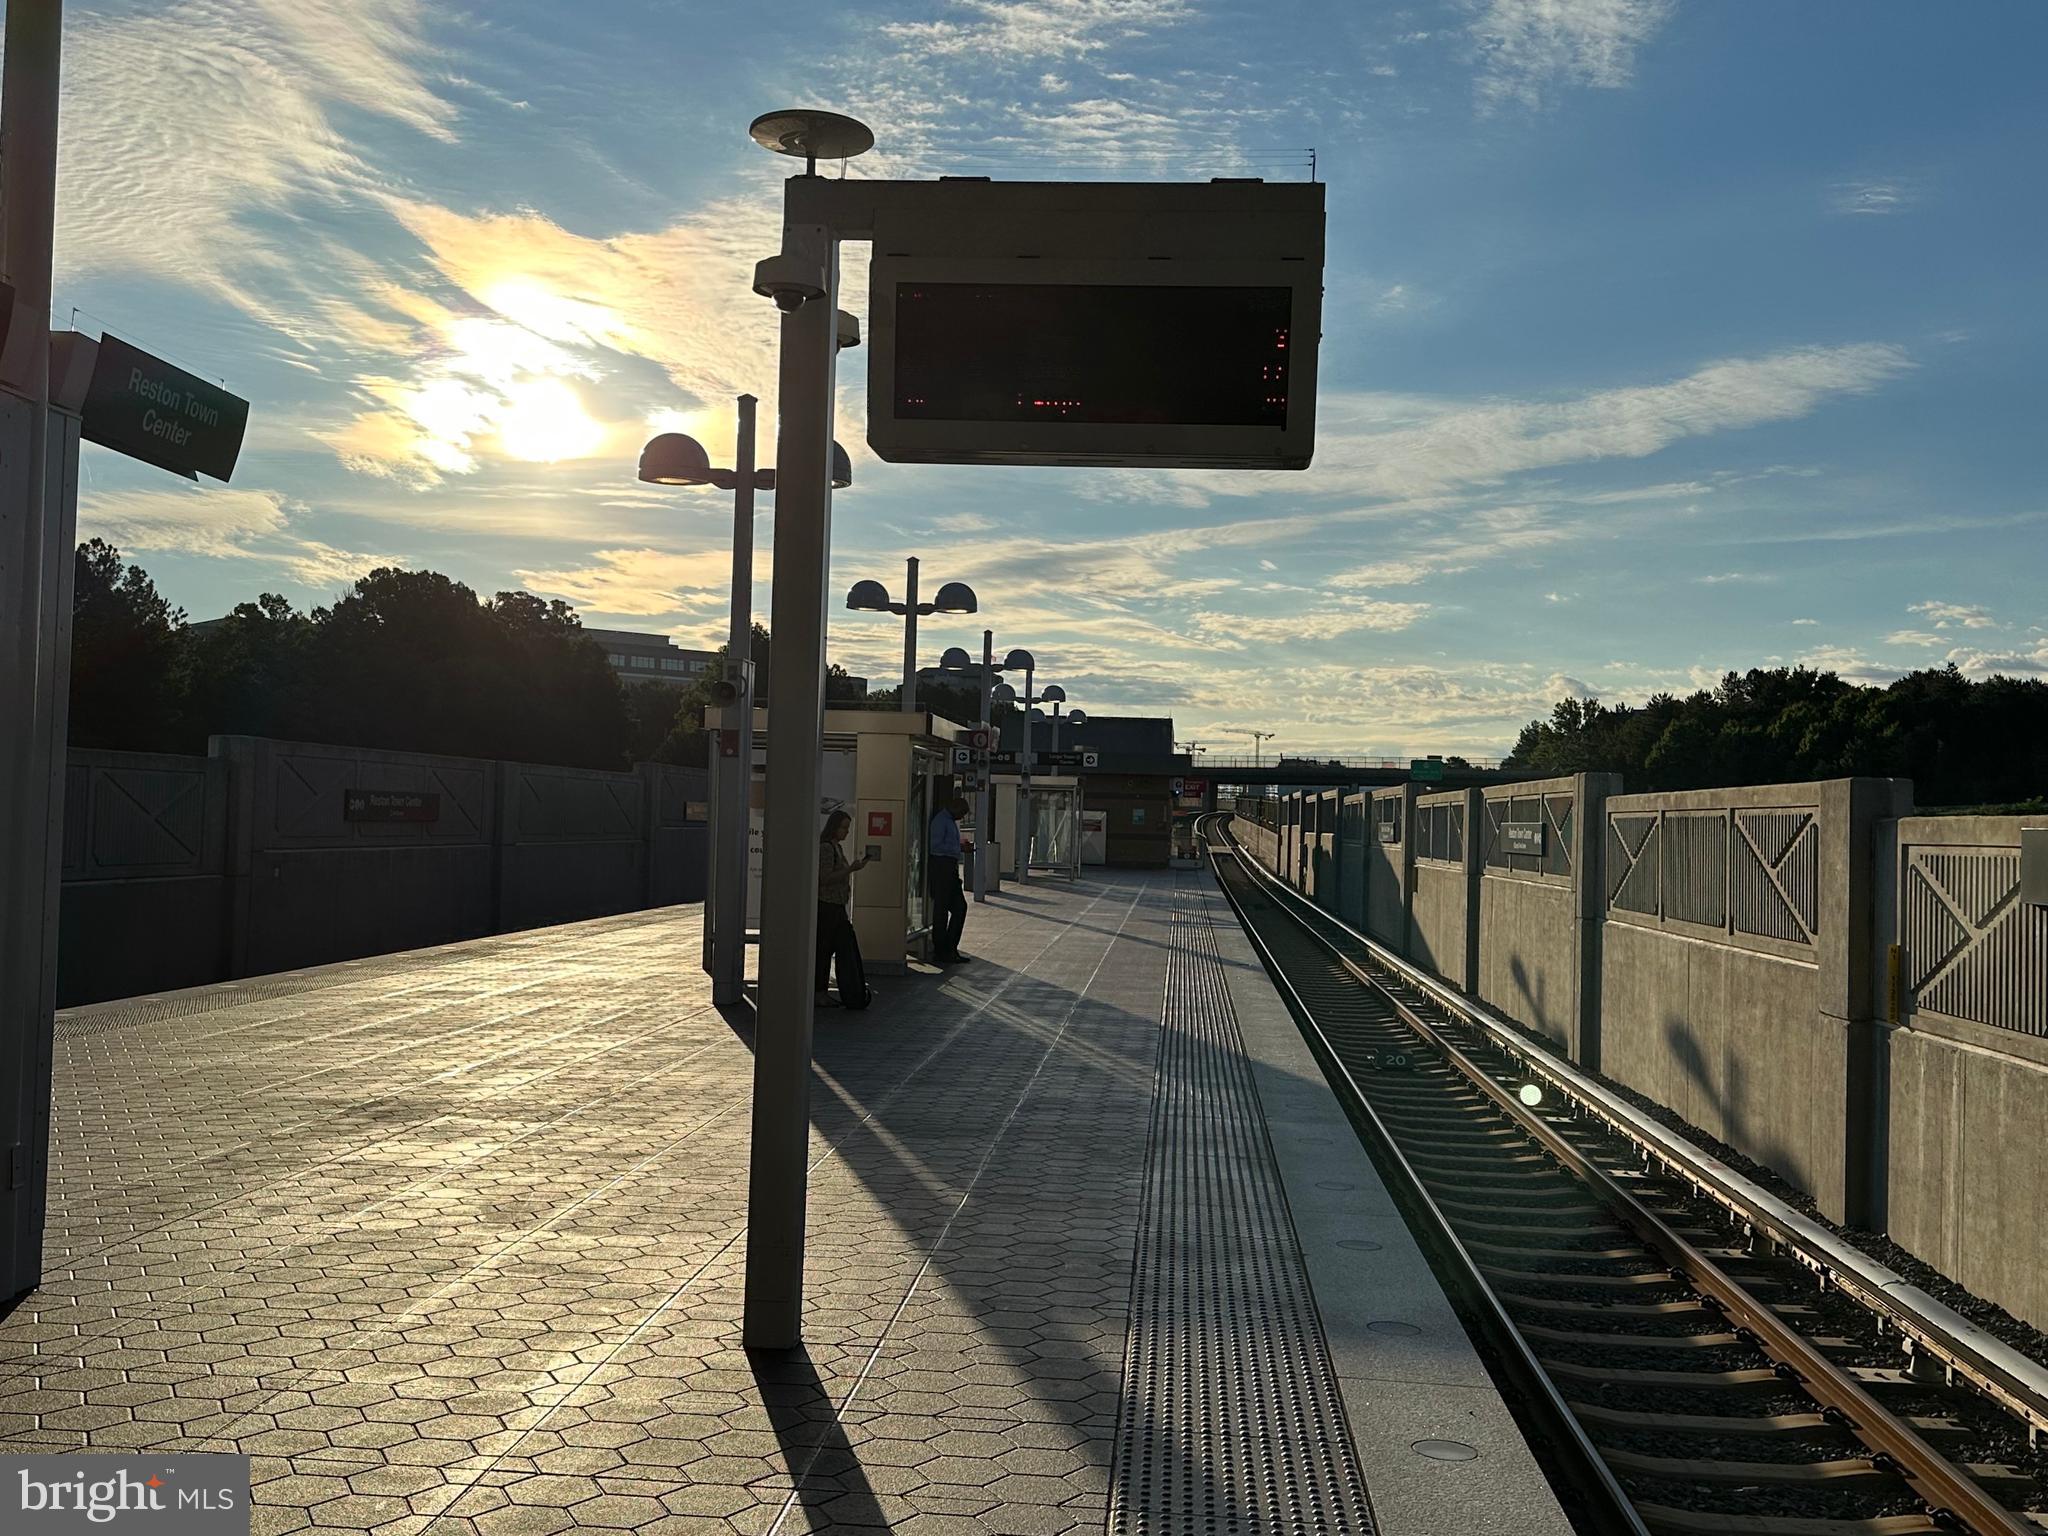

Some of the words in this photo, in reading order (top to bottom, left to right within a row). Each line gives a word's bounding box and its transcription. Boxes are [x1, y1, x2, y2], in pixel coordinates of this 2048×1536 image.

[128, 367, 180, 410] Reston
[185, 392, 218, 427] Town
[143, 409, 192, 446] Center
[1386, 1055, 1406, 1066] 20
